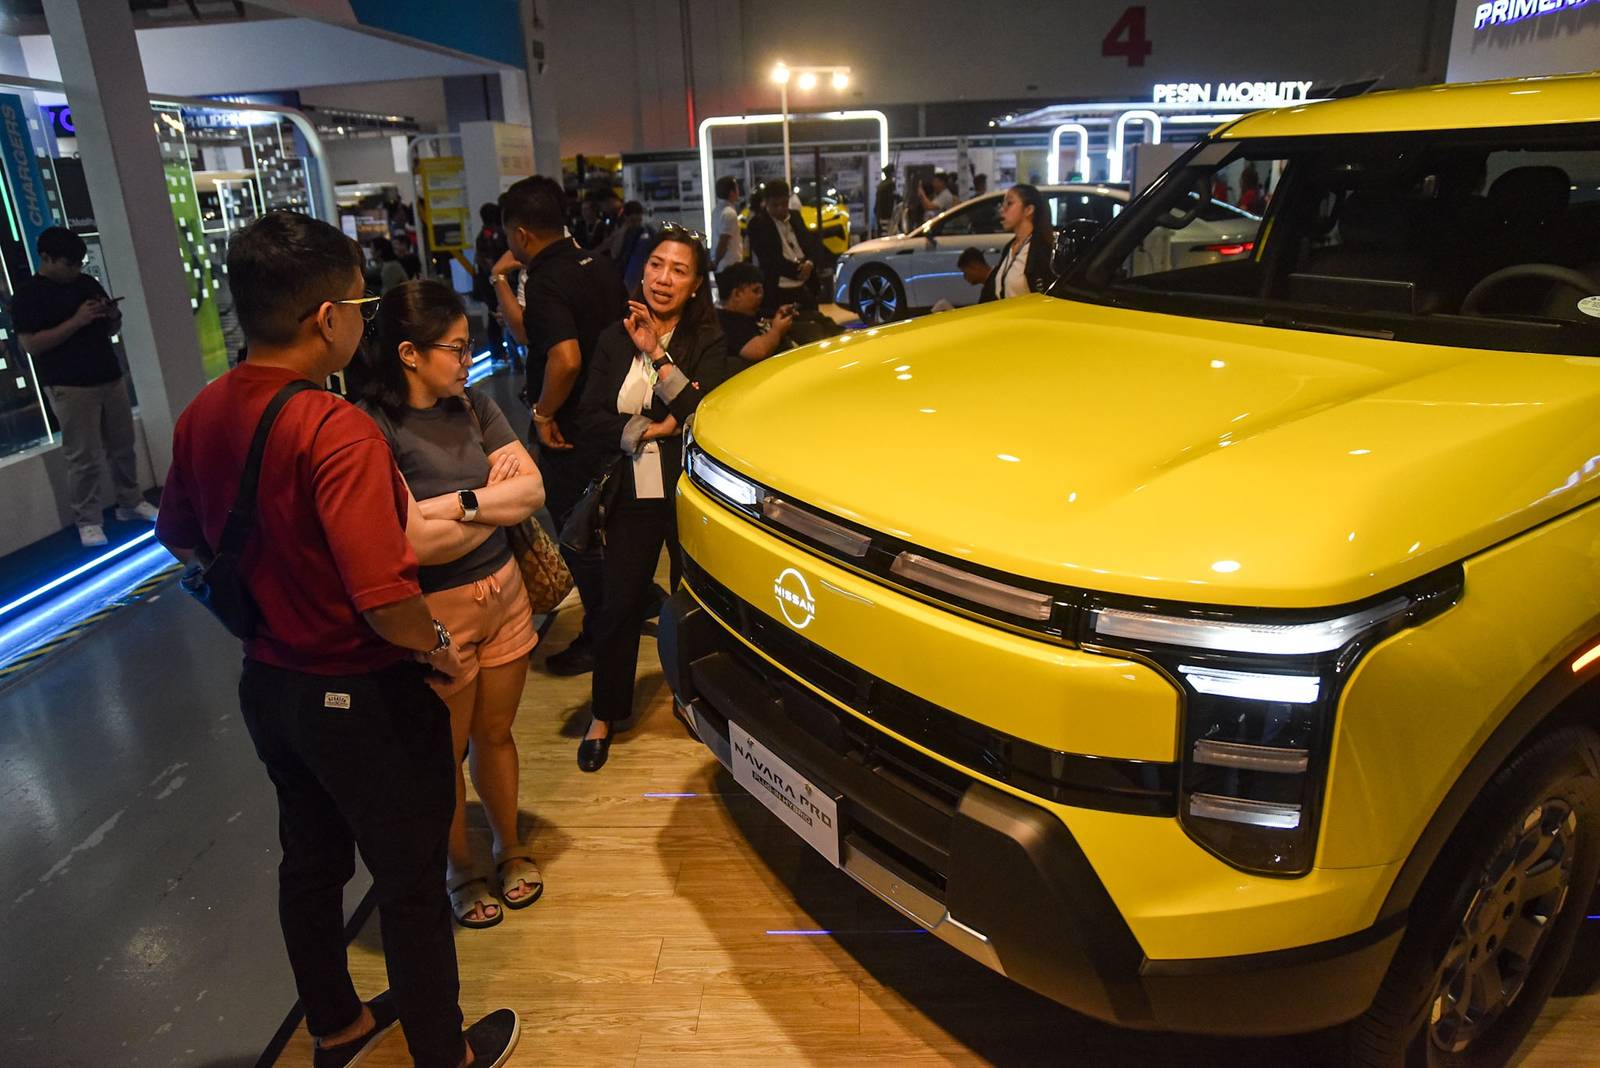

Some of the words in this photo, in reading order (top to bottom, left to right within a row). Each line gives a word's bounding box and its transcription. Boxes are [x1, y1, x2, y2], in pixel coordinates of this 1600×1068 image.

[1102, 6, 1152, 67] 4
[1153, 83, 1211, 103] PESIN
[1216, 81, 1313, 102] MOBILITY
[3, 105, 43, 227] CHARGERS
[774, 583, 815, 615] NISSAN
[734, 741, 796, 799] NAVARA
[800, 795, 832, 828] PRO
